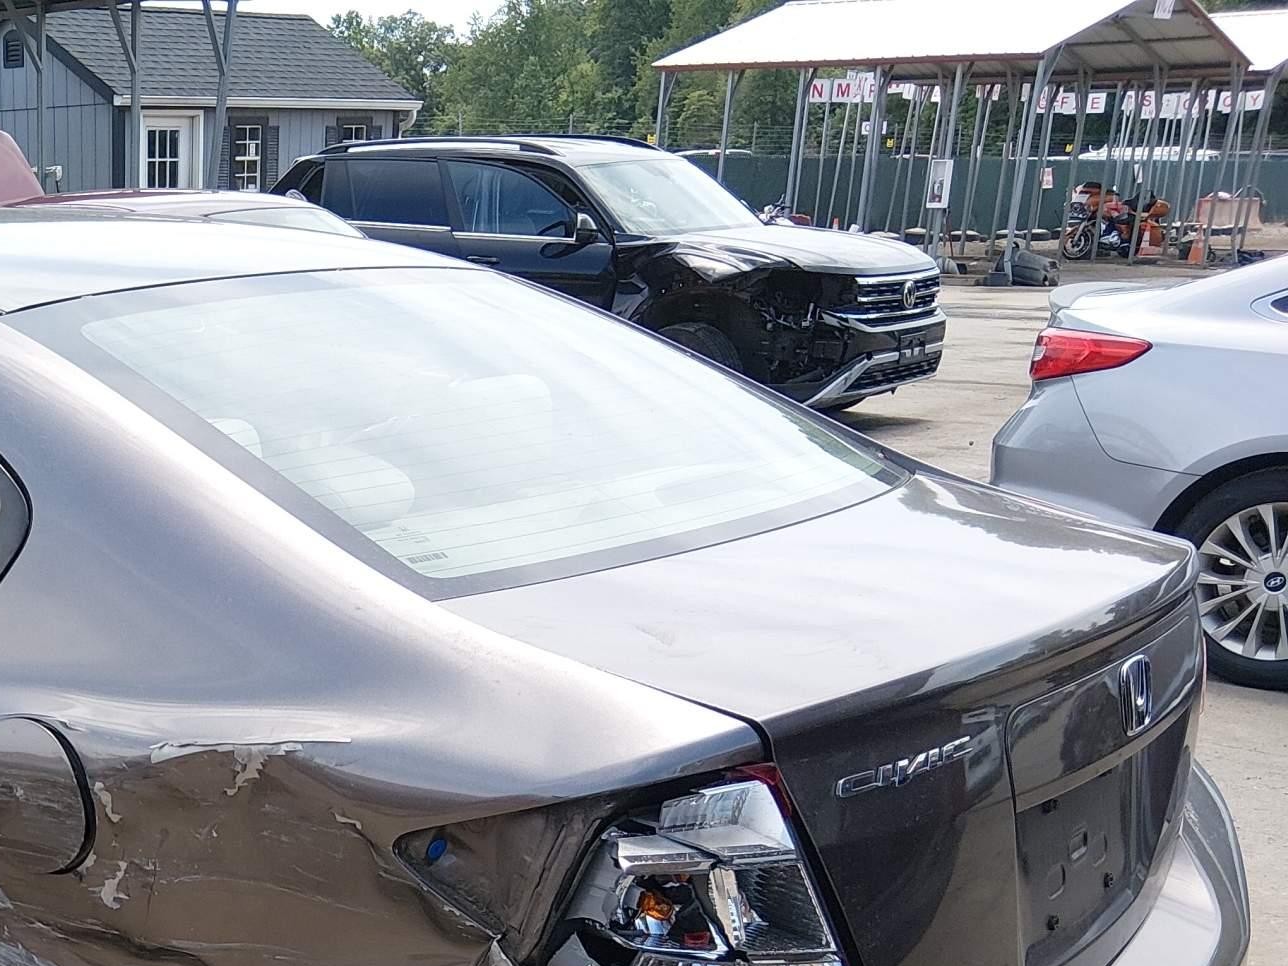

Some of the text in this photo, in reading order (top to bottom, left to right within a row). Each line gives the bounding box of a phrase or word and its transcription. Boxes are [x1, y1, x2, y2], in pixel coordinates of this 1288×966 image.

[812, 83, 824, 98] N
[836, 83, 850, 98] M
[1091, 97, 1100, 109] E
[1143, 95, 1151, 107] S
[1250, 95, 1260, 106] Y
[834, 735, 974, 798] CIVIC
